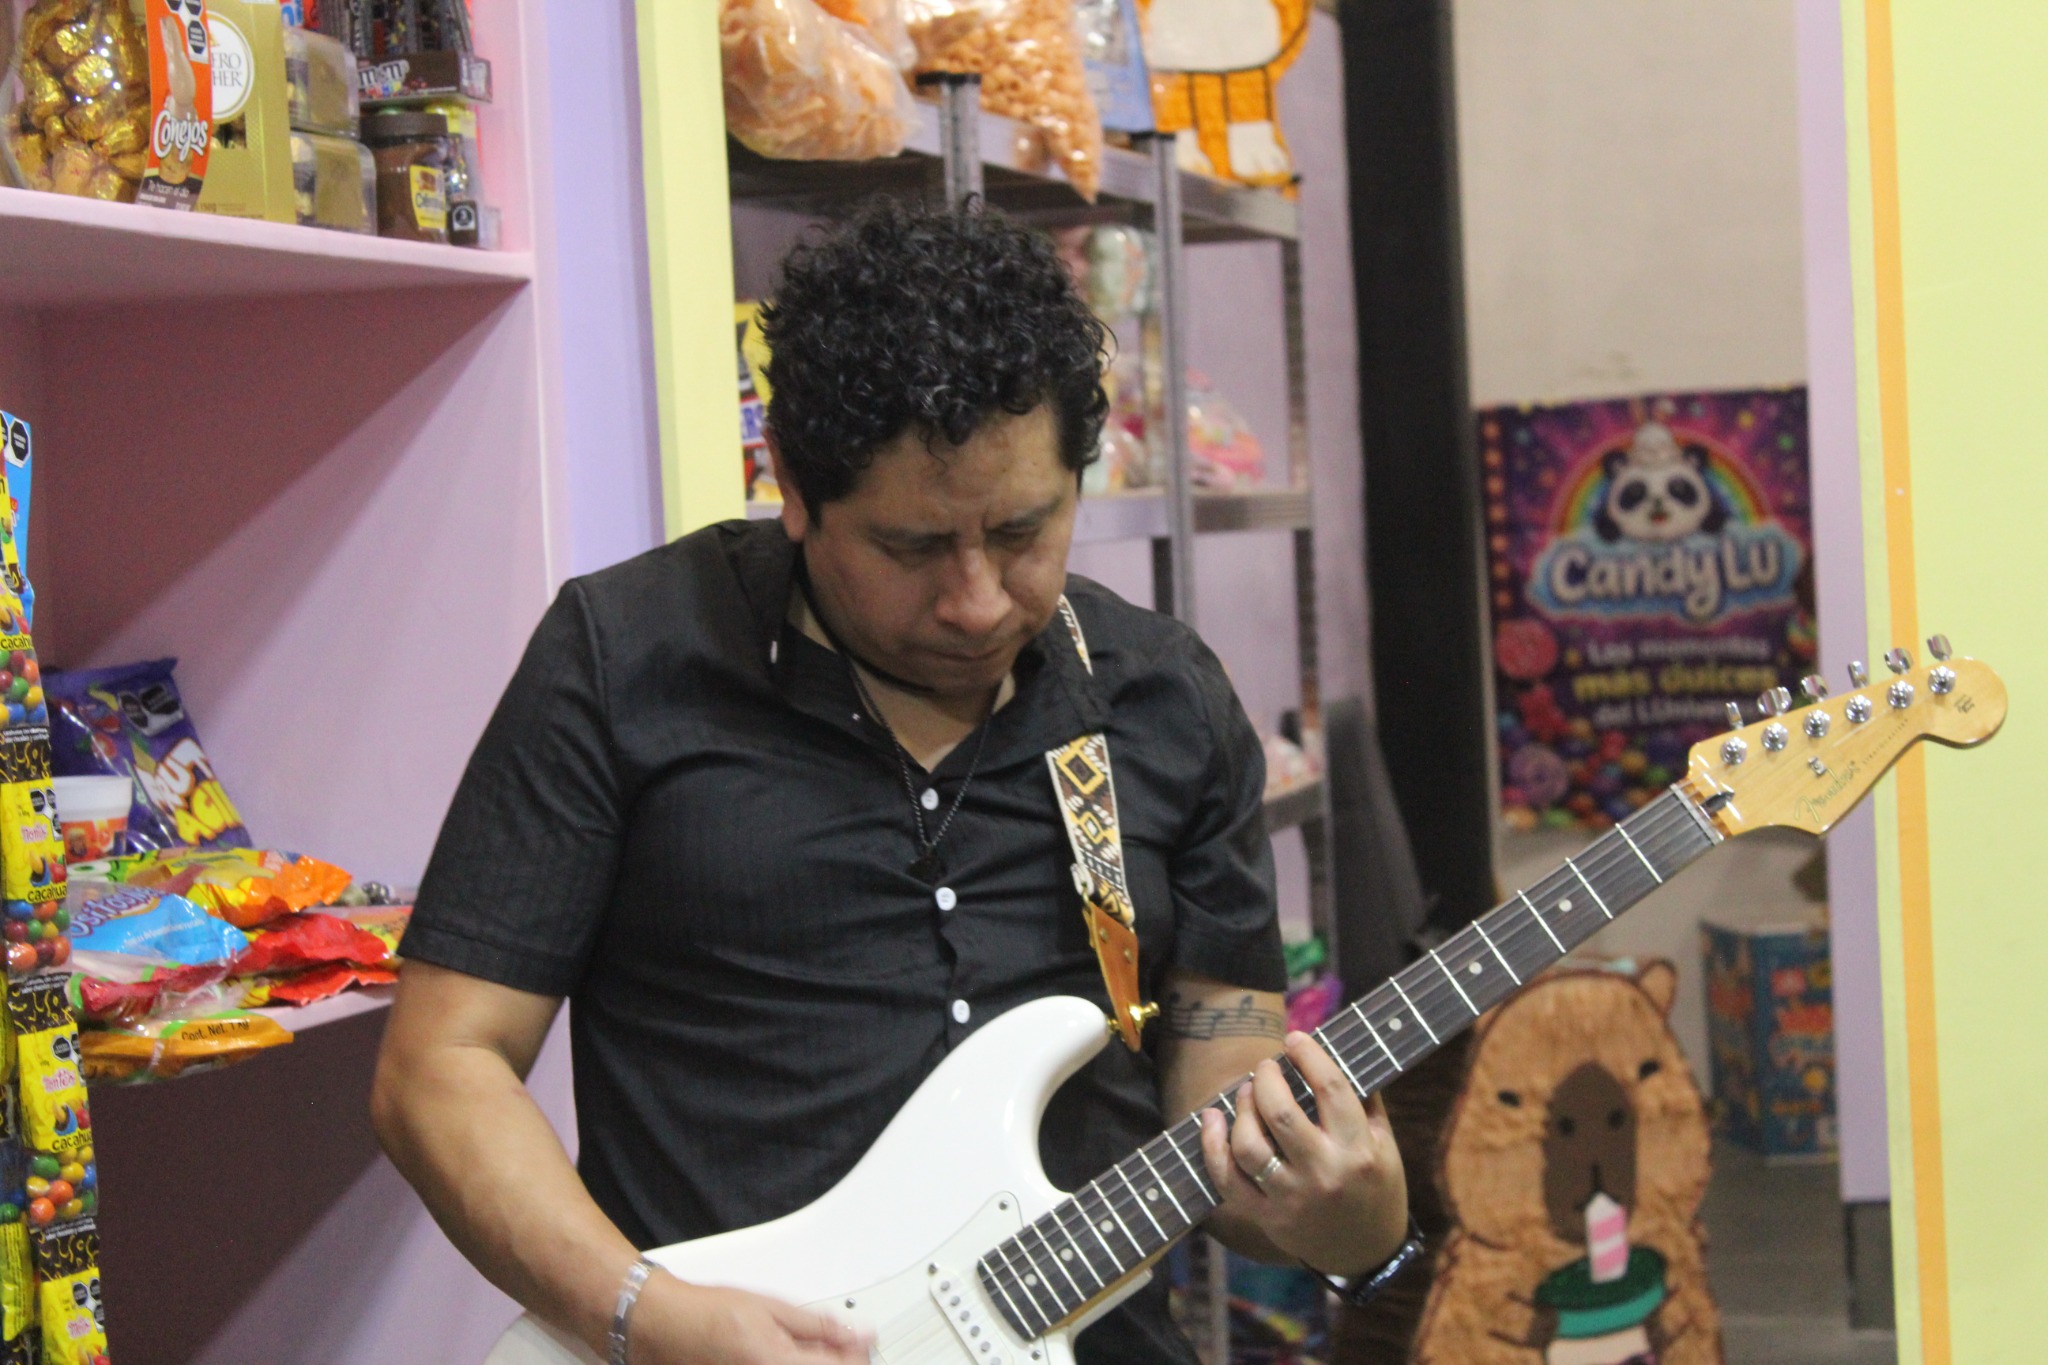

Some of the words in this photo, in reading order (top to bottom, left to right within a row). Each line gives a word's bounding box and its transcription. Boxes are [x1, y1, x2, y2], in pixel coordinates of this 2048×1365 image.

[211, 52, 242, 70] ERO
[211, 70, 243, 87] HER
[153, 110, 208, 162] Conejos
[1551, 546, 1720, 619] Candy
